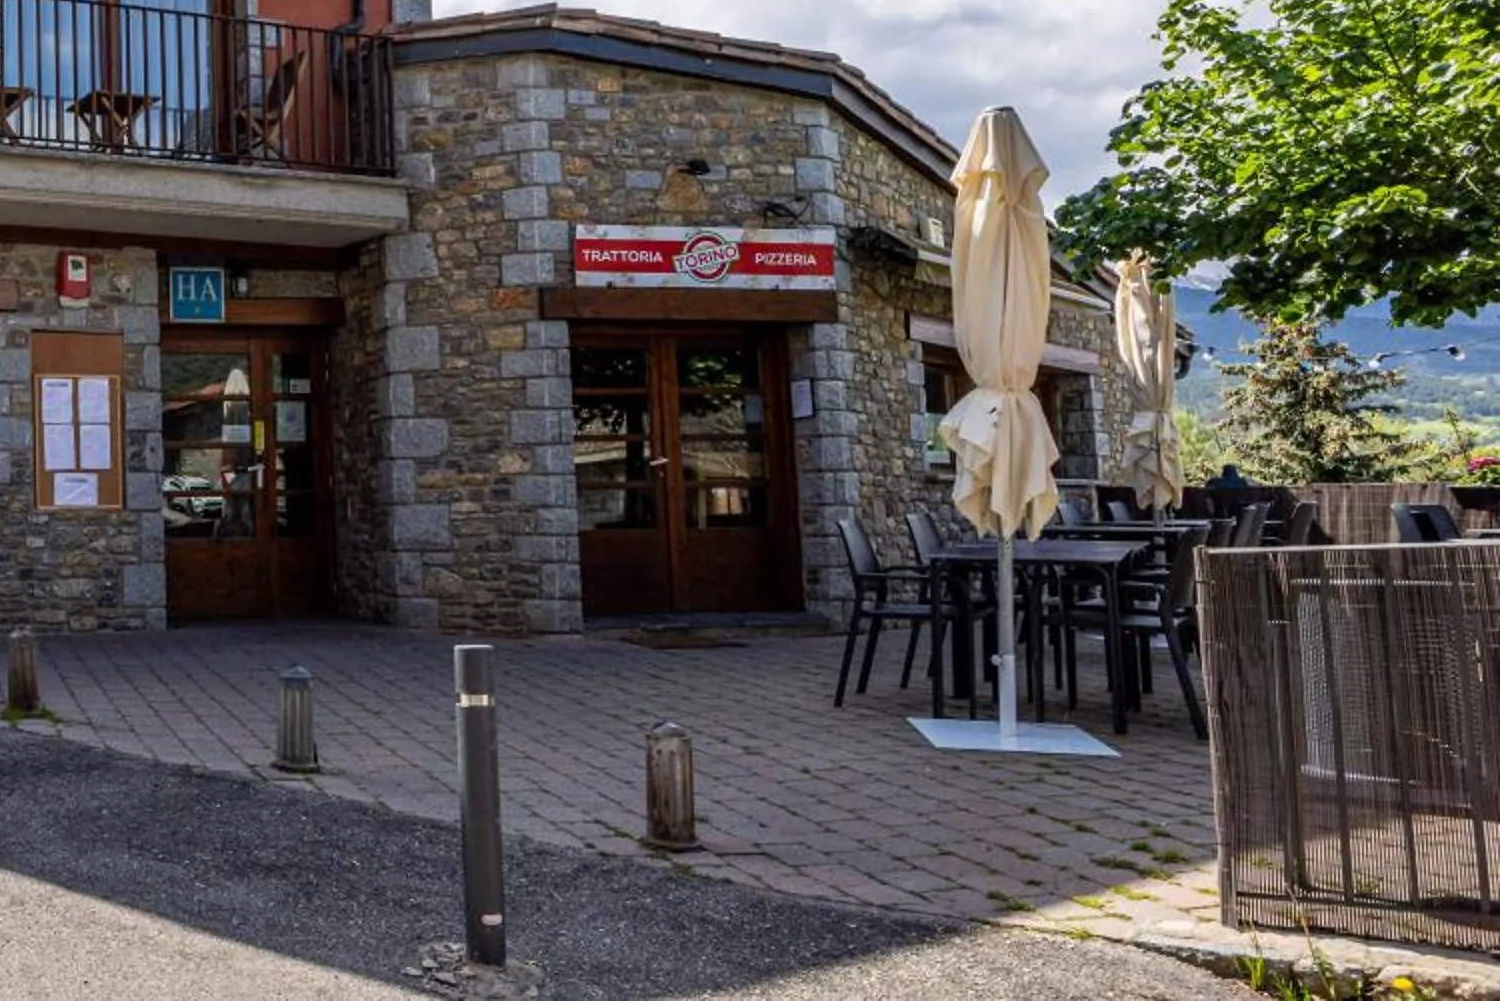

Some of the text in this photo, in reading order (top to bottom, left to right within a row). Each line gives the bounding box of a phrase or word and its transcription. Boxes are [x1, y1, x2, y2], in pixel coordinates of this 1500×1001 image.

[581, 245, 817, 270] TRATTORIA TORINO PIZZERIA
[176, 273, 217, 302] HA
